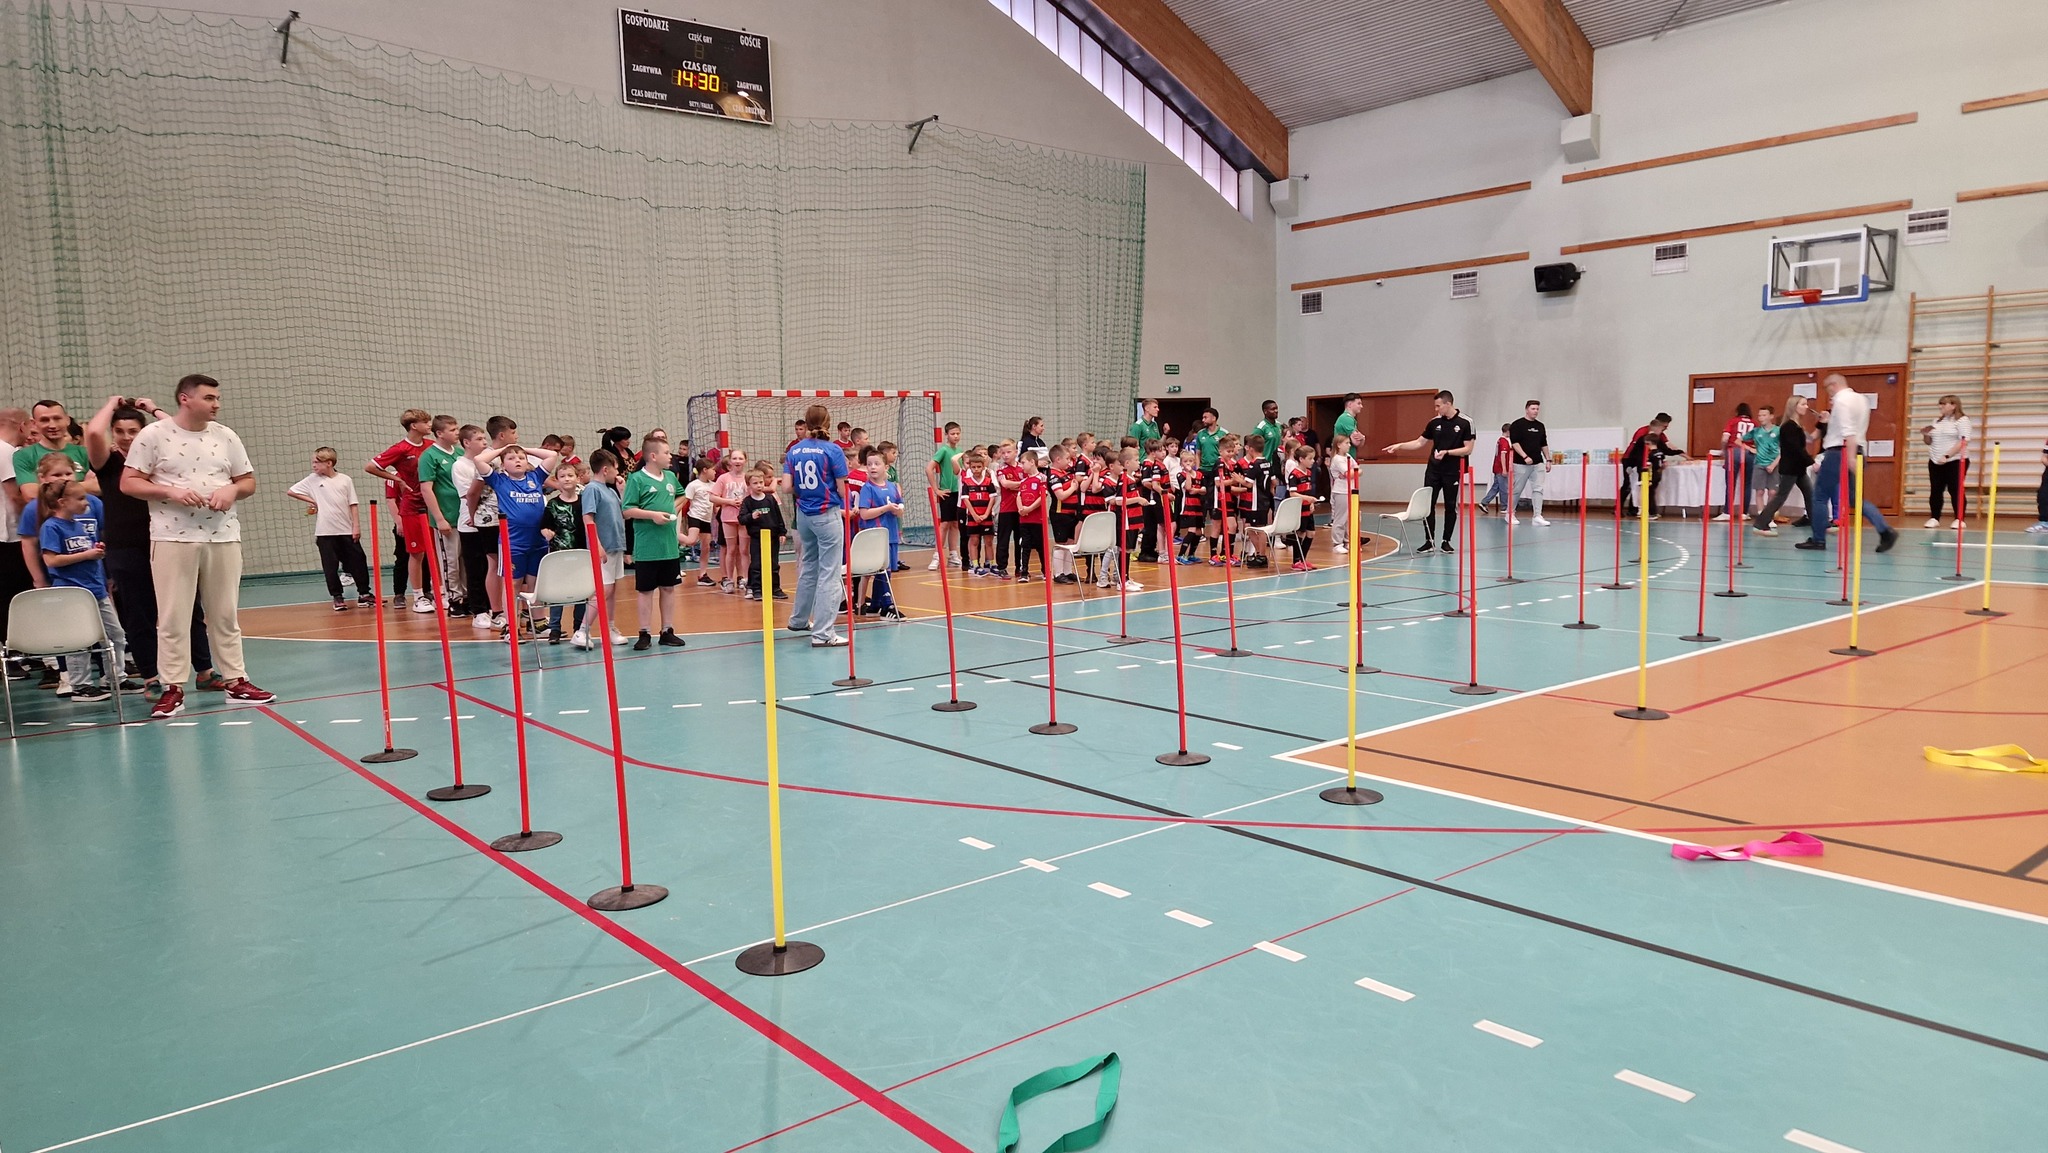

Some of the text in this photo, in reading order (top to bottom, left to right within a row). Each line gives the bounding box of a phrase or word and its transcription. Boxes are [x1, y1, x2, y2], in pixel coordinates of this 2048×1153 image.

[625, 13, 670, 32] GOSPODARZE
[702, 35, 713, 44] GRY
[739, 34, 762, 49] GOŚCIE
[631, 63, 663, 76] ZAGRYWKA
[682, 60, 717, 74] CZAS GRY
[677, 69, 720, 93] 14:30
[736, 80, 763, 92] ZAGRYWKA
[631, 88, 668, 101] CZAS DRUŻYNY
[794, 460, 818, 490] 18
